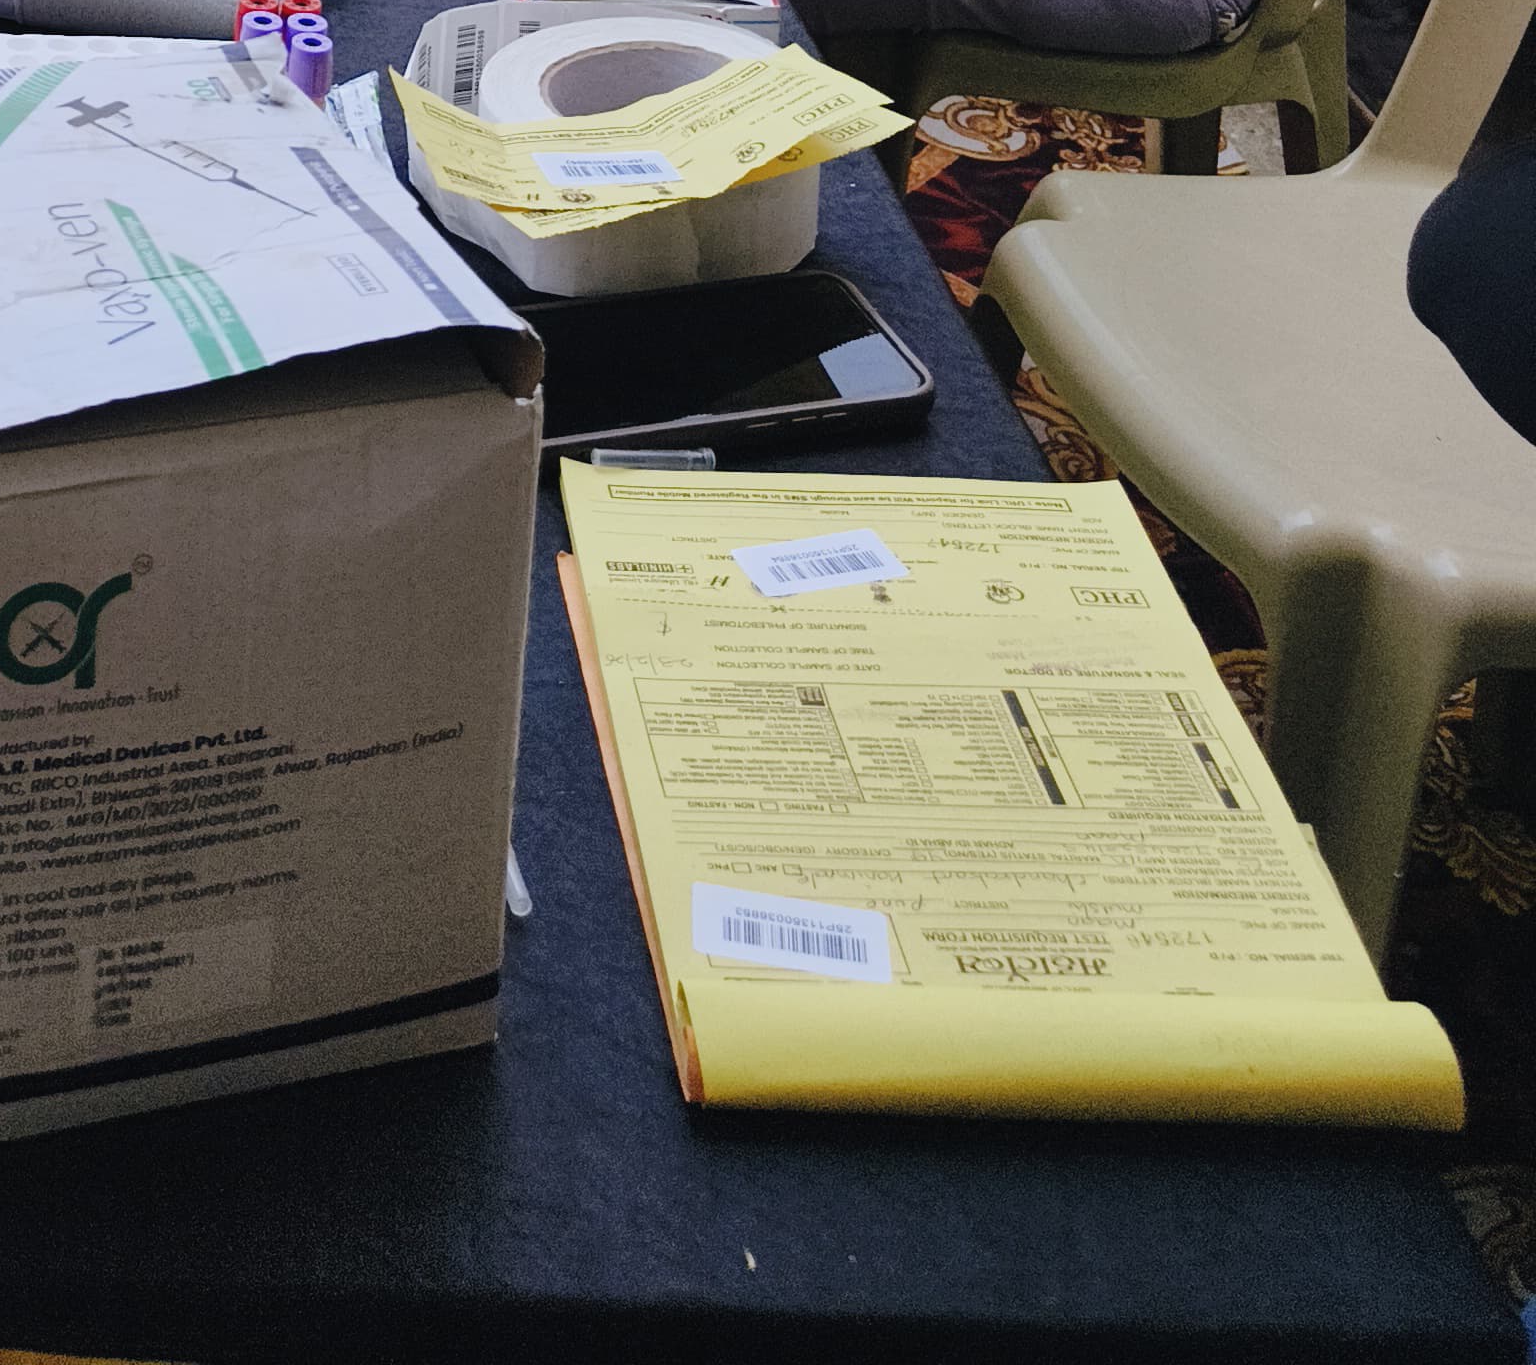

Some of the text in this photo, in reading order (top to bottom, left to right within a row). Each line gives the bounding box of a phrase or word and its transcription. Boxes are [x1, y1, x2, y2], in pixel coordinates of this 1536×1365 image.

[1079, 590, 1140, 605] PHC
[1077, 669, 1141, 677] SIGNATURE
[33, 747, 113, 773] Medical
[115, 736, 192, 762] Devices
[194, 734, 229, 751] Pvt.
[234, 726, 269, 745] Ltd.
[83, 760, 165, 786] Industrial
[825, 847, 891, 857] CATEGORY
[4, 893, 21, 907] in
[25, 888, 64, 906] cool
[69, 882, 108, 900] and
[72, 903, 107, 918] use
[110, 899, 132, 914] as
[135, 891, 166, 912] per
[922, 931, 968, 942] FORM
[972, 931, 1065, 944] REQUISITION
